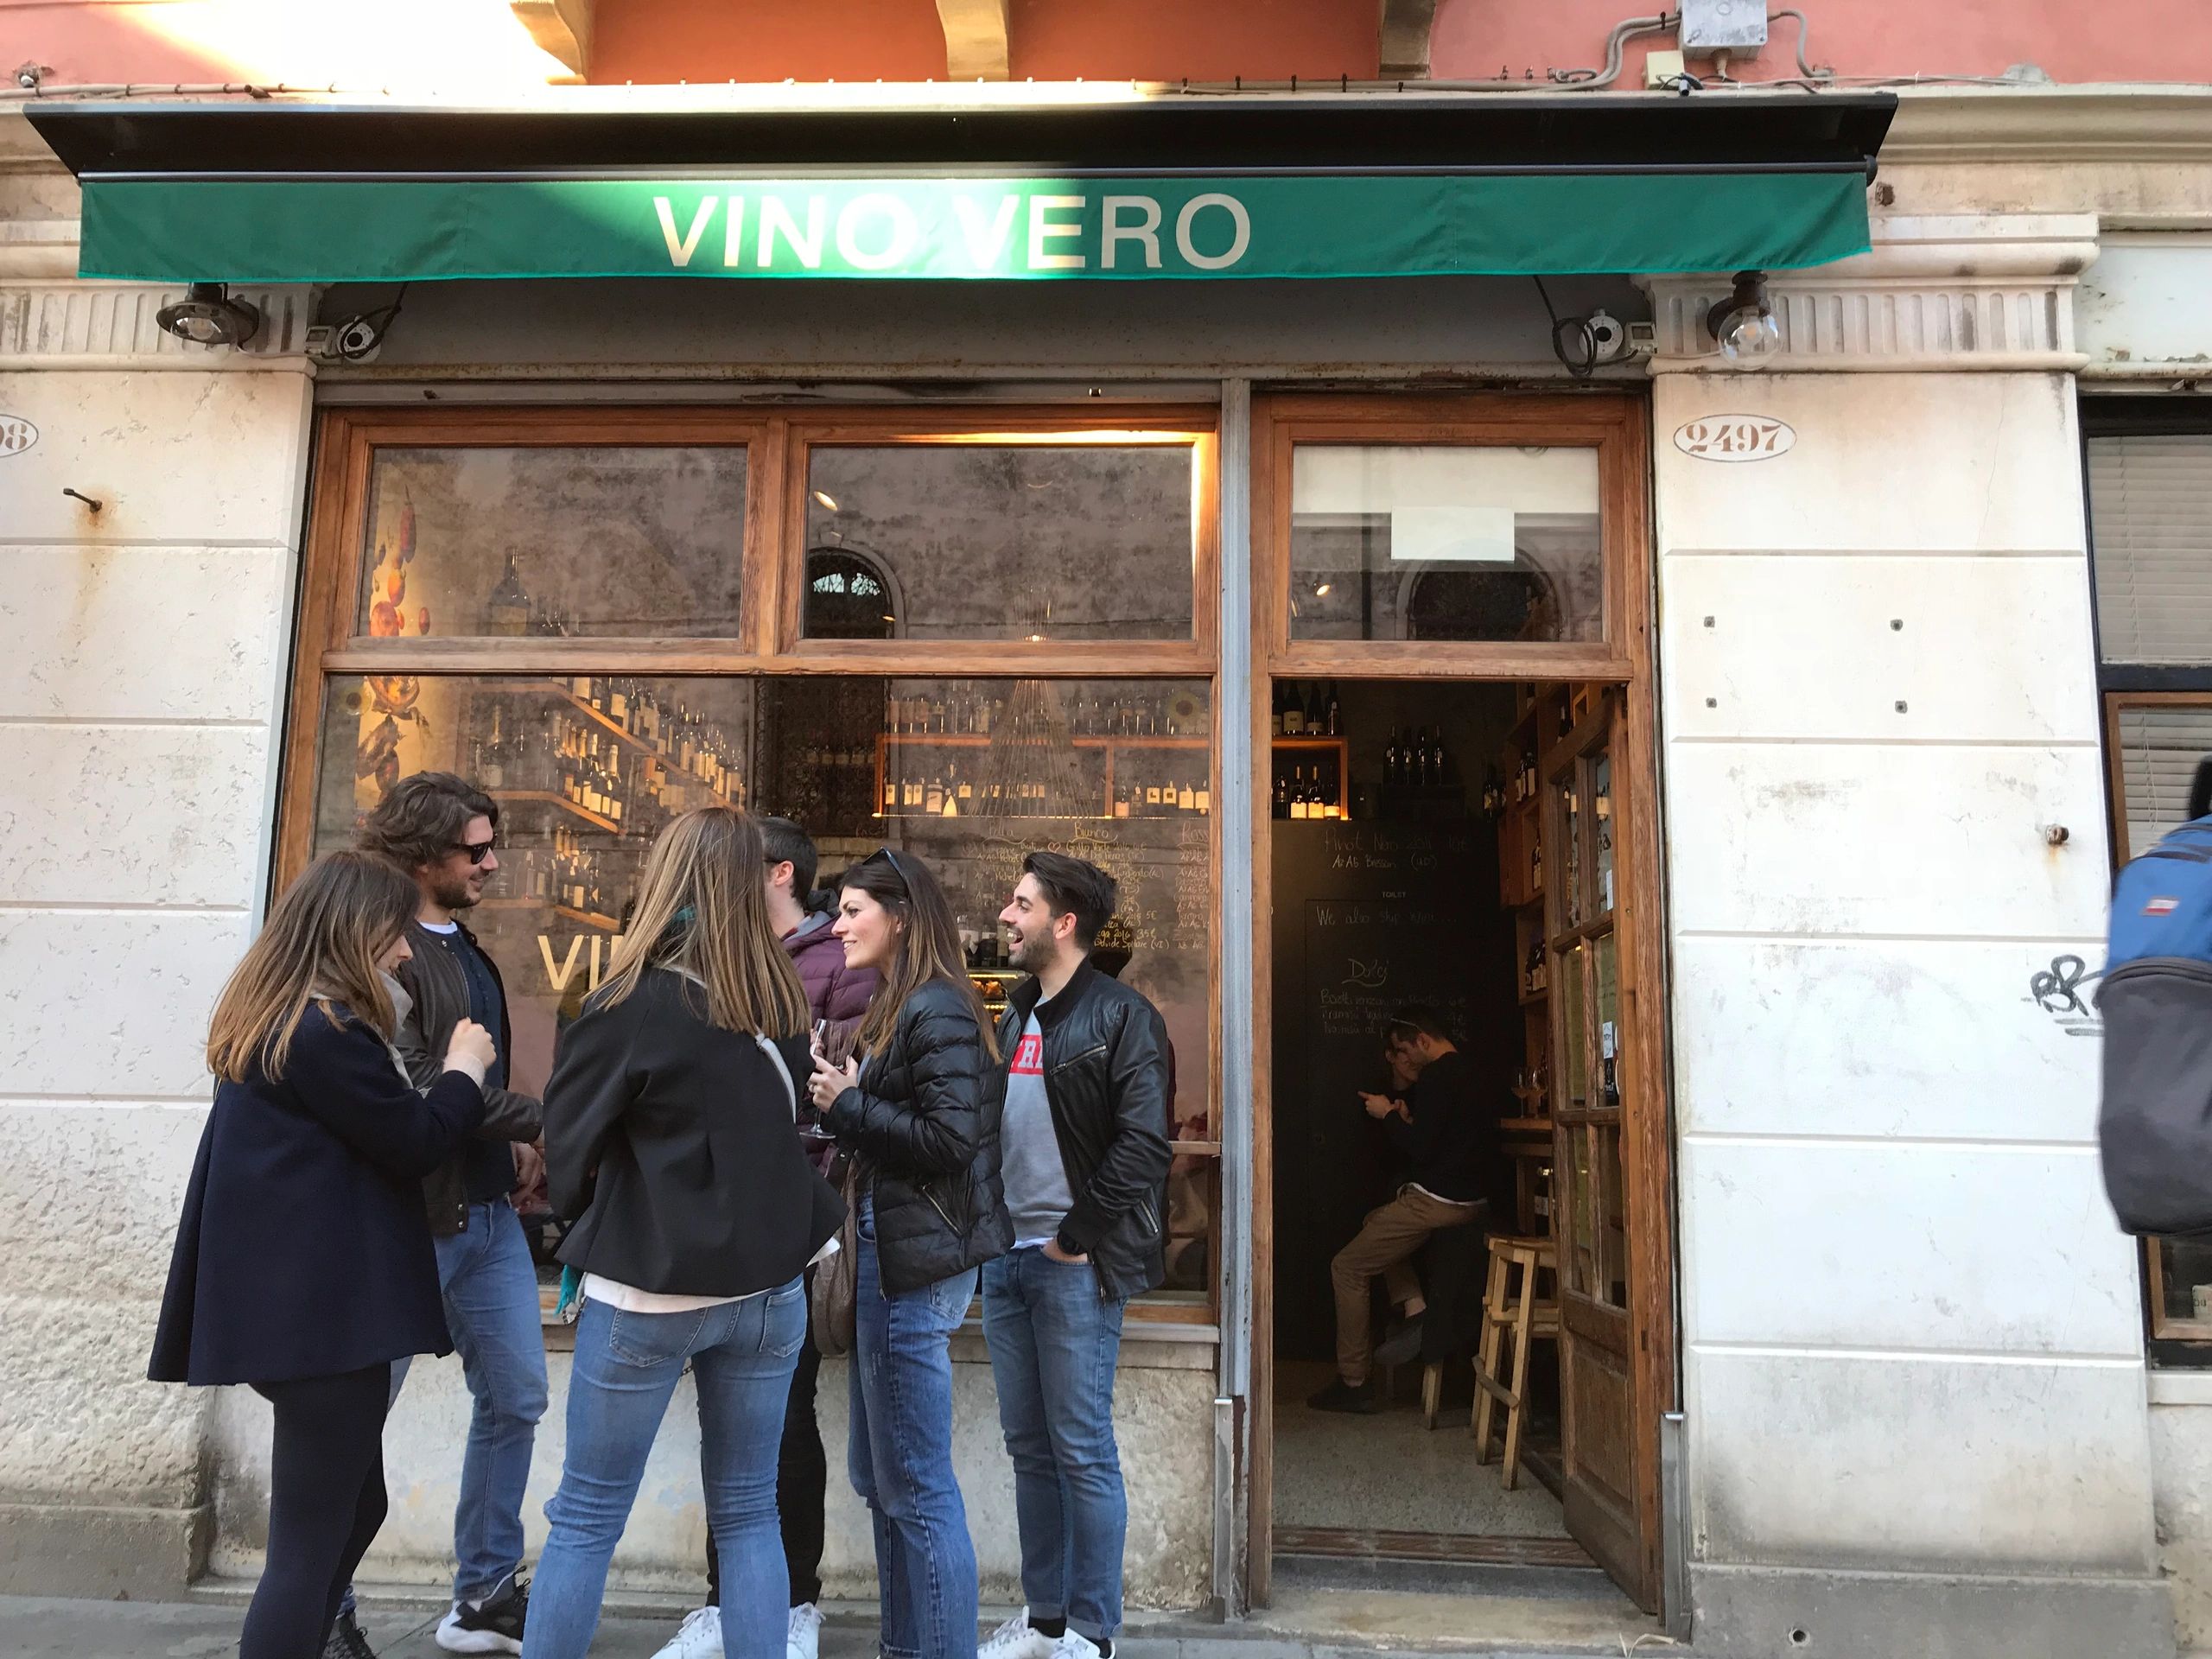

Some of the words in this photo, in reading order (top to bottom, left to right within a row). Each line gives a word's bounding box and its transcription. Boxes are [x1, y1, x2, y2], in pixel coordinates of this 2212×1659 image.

[652, 193, 918, 270] VINO
[950, 193, 1251, 270] VERO
[1686, 423, 1782, 453] 2497
[1316, 906, 1336, 926] We
